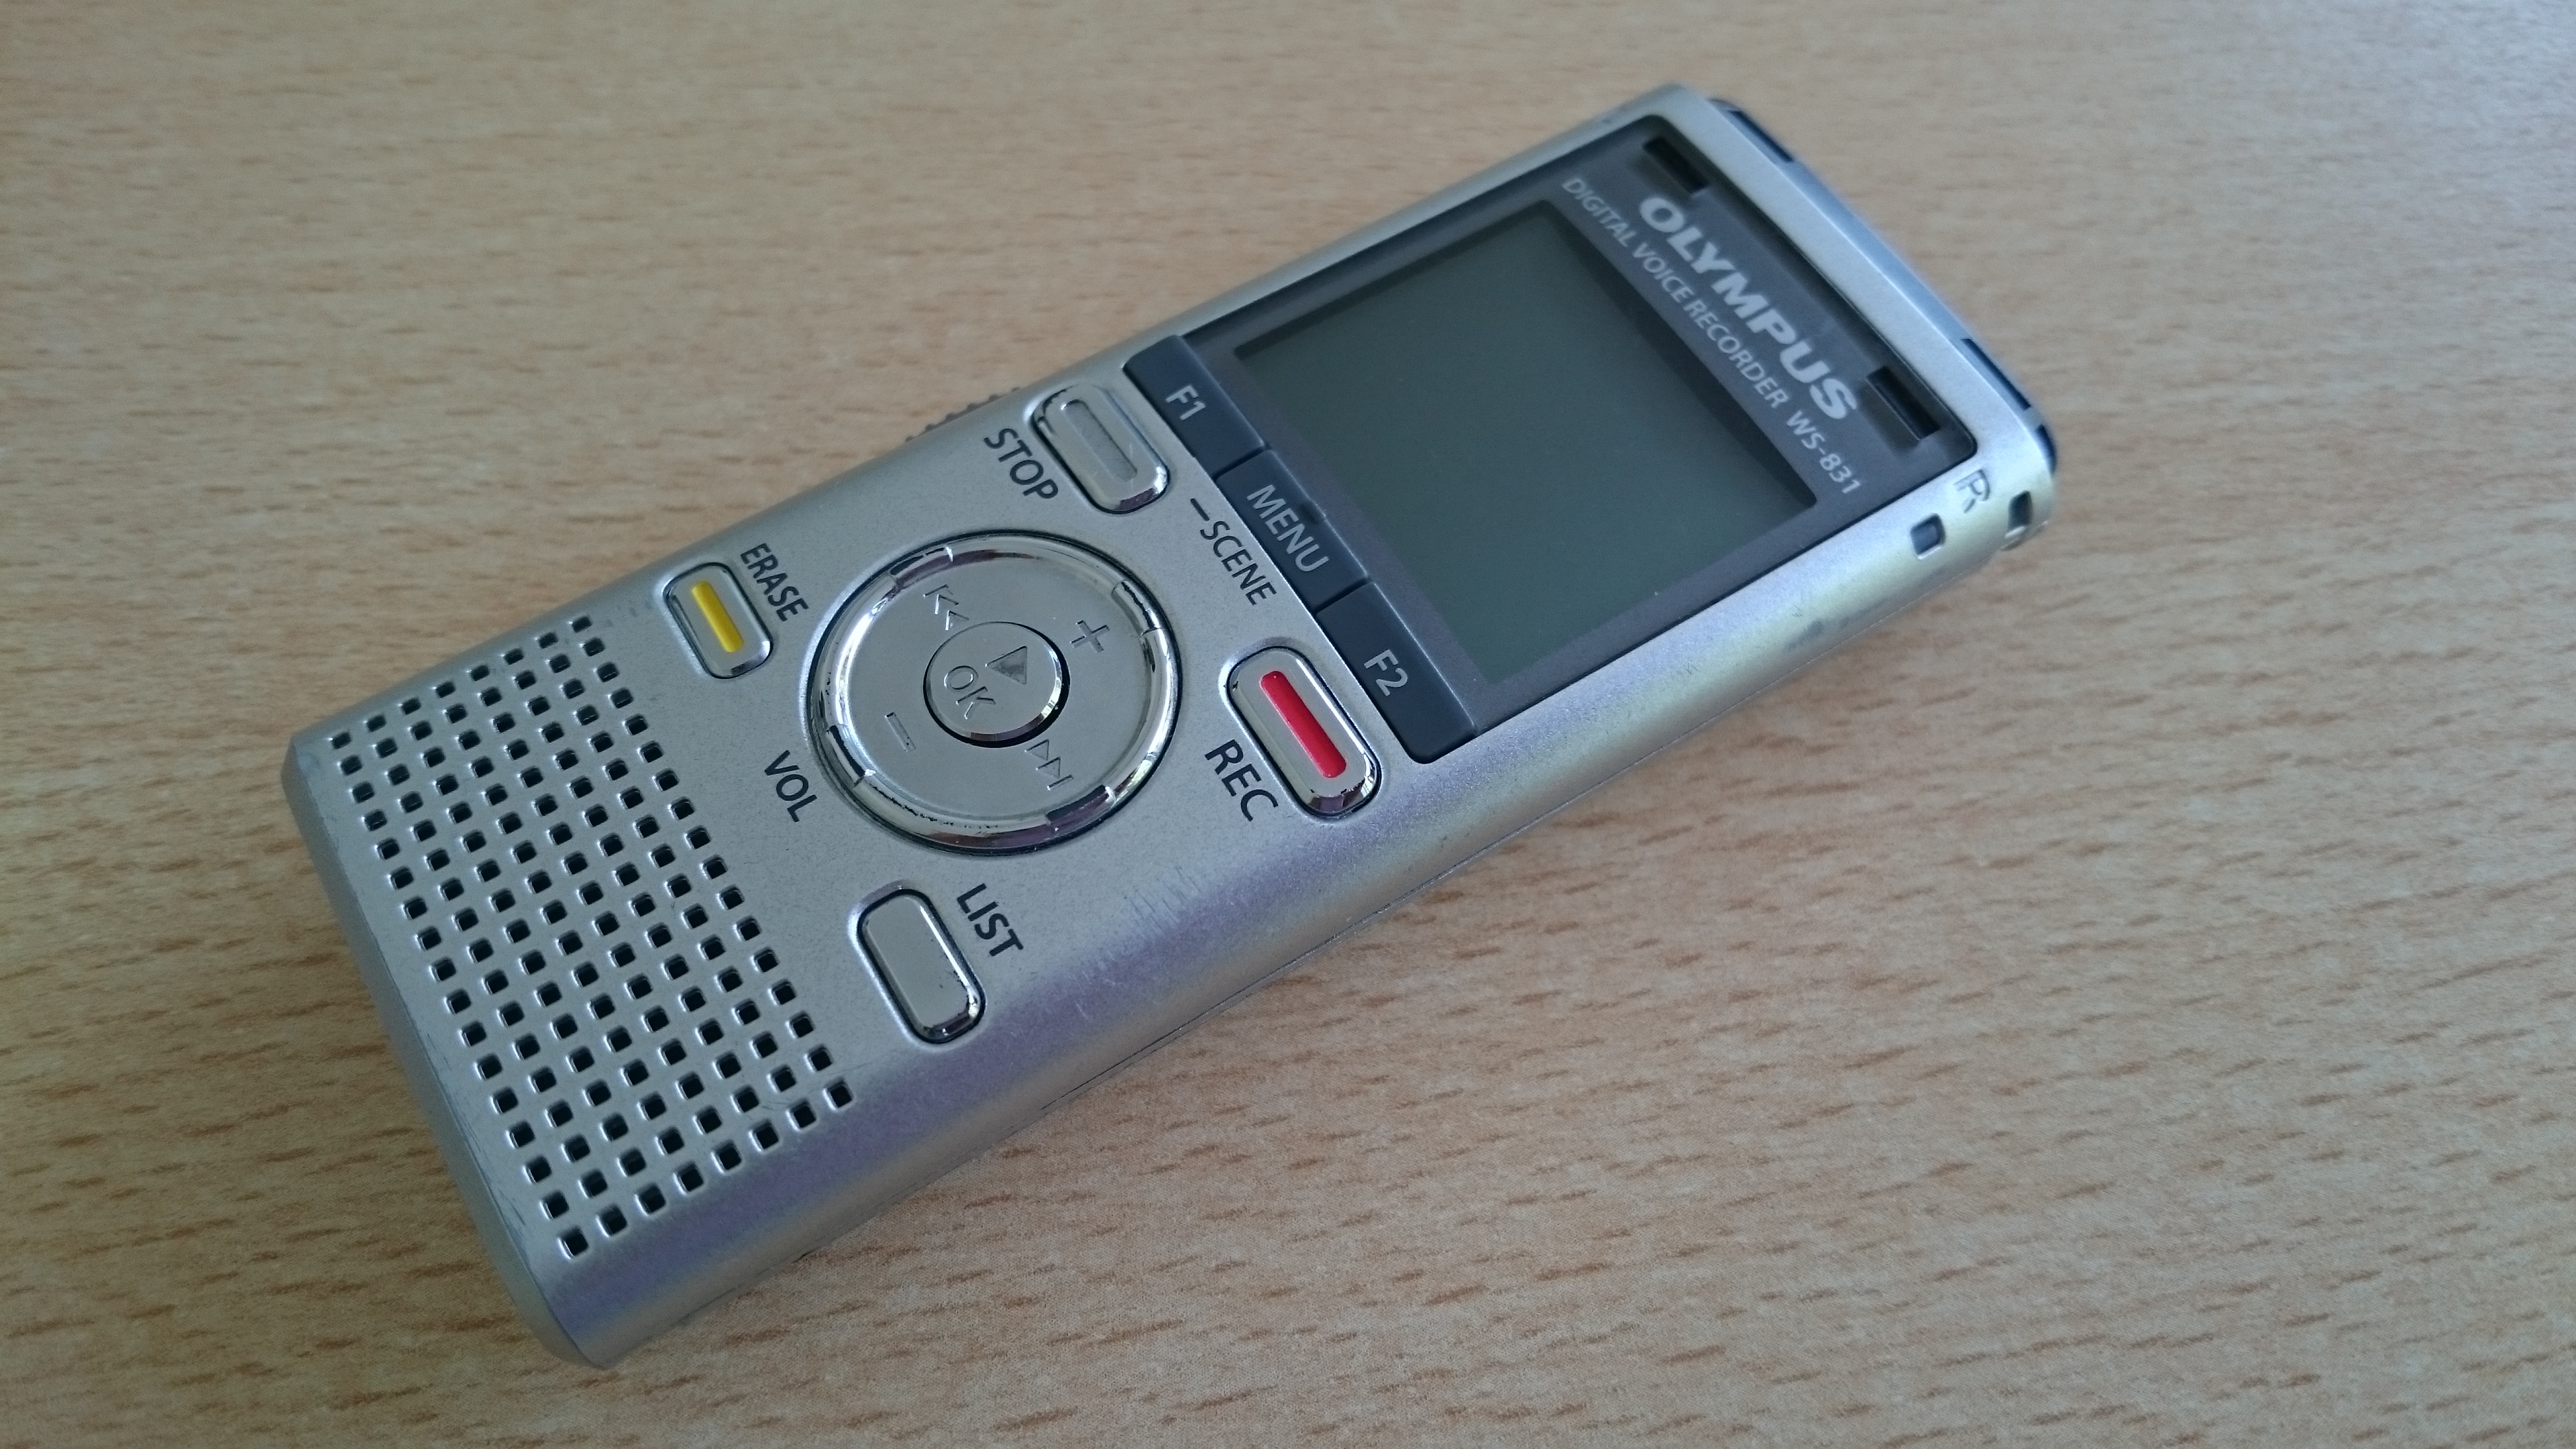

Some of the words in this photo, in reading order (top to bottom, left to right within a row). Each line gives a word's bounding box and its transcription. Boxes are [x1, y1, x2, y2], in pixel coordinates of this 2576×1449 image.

[1562, 177, 1638, 248] DIGITAL
[1631, 239, 1694, 302] VOICE
[1683, 299, 1790, 410] RECORDER
[1786, 411, 1861, 495] WS-831
[1639, 197, 1858, 420] OLYMPUS
[1165, 384, 1206, 421] F1
[983, 427, 1059, 502] STOP
[1953, 468, 1990, 514] R
[1199, 518, 1277, 605] SCENE
[1246, 484, 1330, 573] MENU
[739, 543, 808, 623] ERASE
[943, 664, 997, 720] OK
[1364, 649, 1409, 698] F2
[763, 749, 819, 823] VOL
[1204, 739, 1279, 822] REC
[957, 882, 1024, 957] LIST
